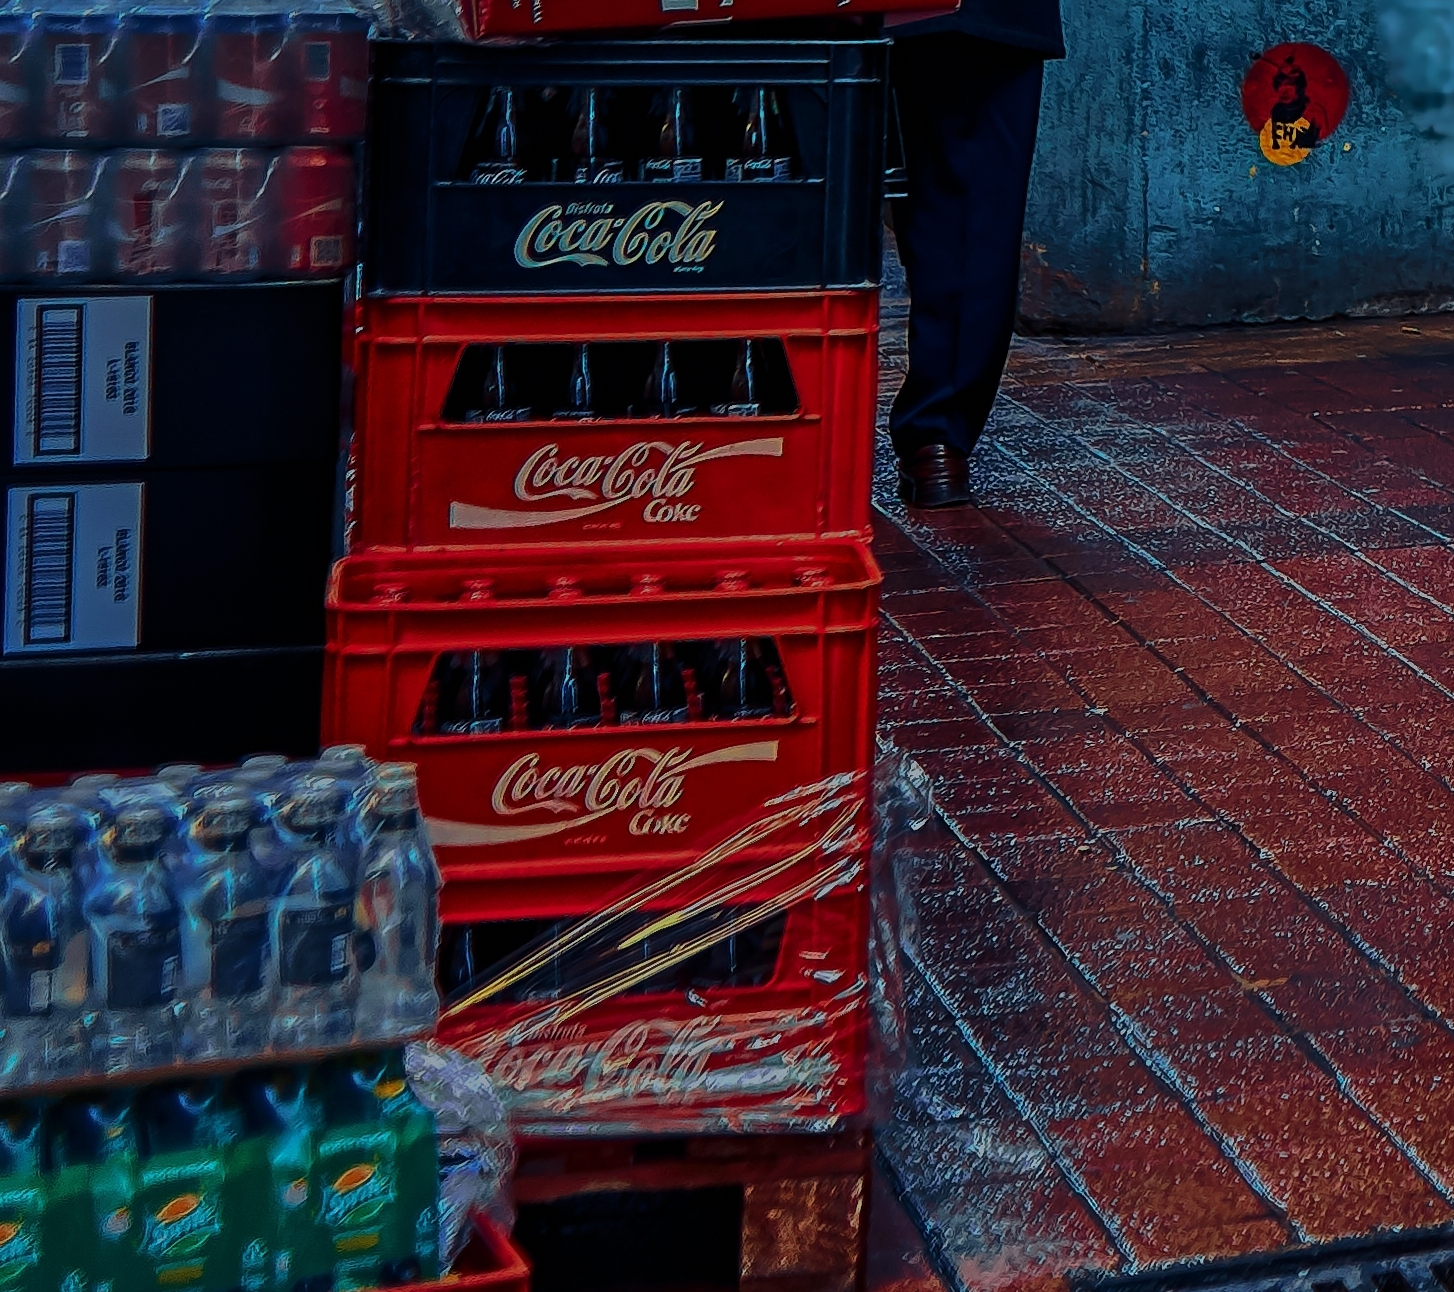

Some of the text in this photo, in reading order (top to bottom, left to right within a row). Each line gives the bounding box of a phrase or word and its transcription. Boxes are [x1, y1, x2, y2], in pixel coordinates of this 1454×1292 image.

[513, 199, 726, 269] Coca-Cola
[513, 440, 705, 503] Coca-Cola
[490, 746, 692, 818] Coca-Cola
